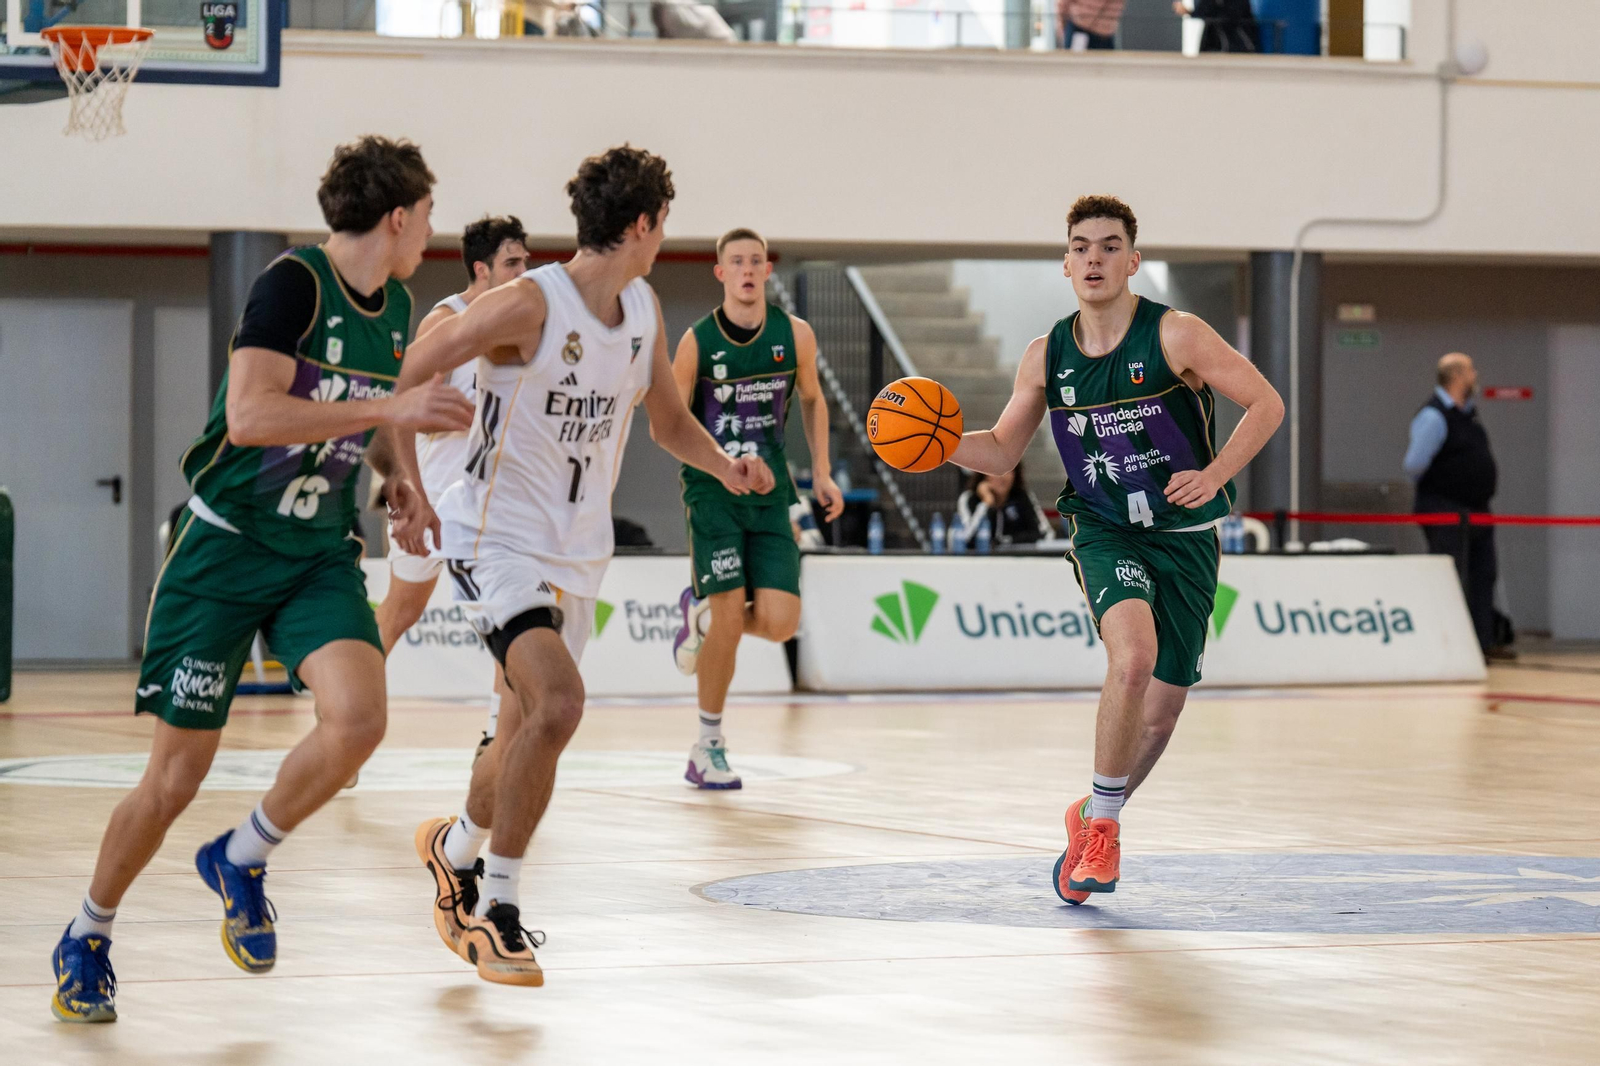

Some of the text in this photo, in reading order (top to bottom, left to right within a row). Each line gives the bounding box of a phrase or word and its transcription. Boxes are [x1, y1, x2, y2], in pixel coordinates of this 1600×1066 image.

[203, 4, 237, 17] LIGA
[735, 379, 787, 394] Fundación
[735, 390, 774, 403] Unicaja
[1091, 404, 1162, 426] Fundación
[559, 421, 587, 443] FLY
[1094, 419, 1145, 438] Unicaja
[1125, 462, 1139, 474] de
[1139, 460, 1149, 470] la
[277, 475, 330, 520] 13
[1127, 490, 1154, 528] 4
[953, 601, 1096, 648] Unicaj
[1254, 599, 1415, 644] Unicaja
[182, 655, 226, 673] CLINICAS
[172, 695, 214, 713] DENTAL
